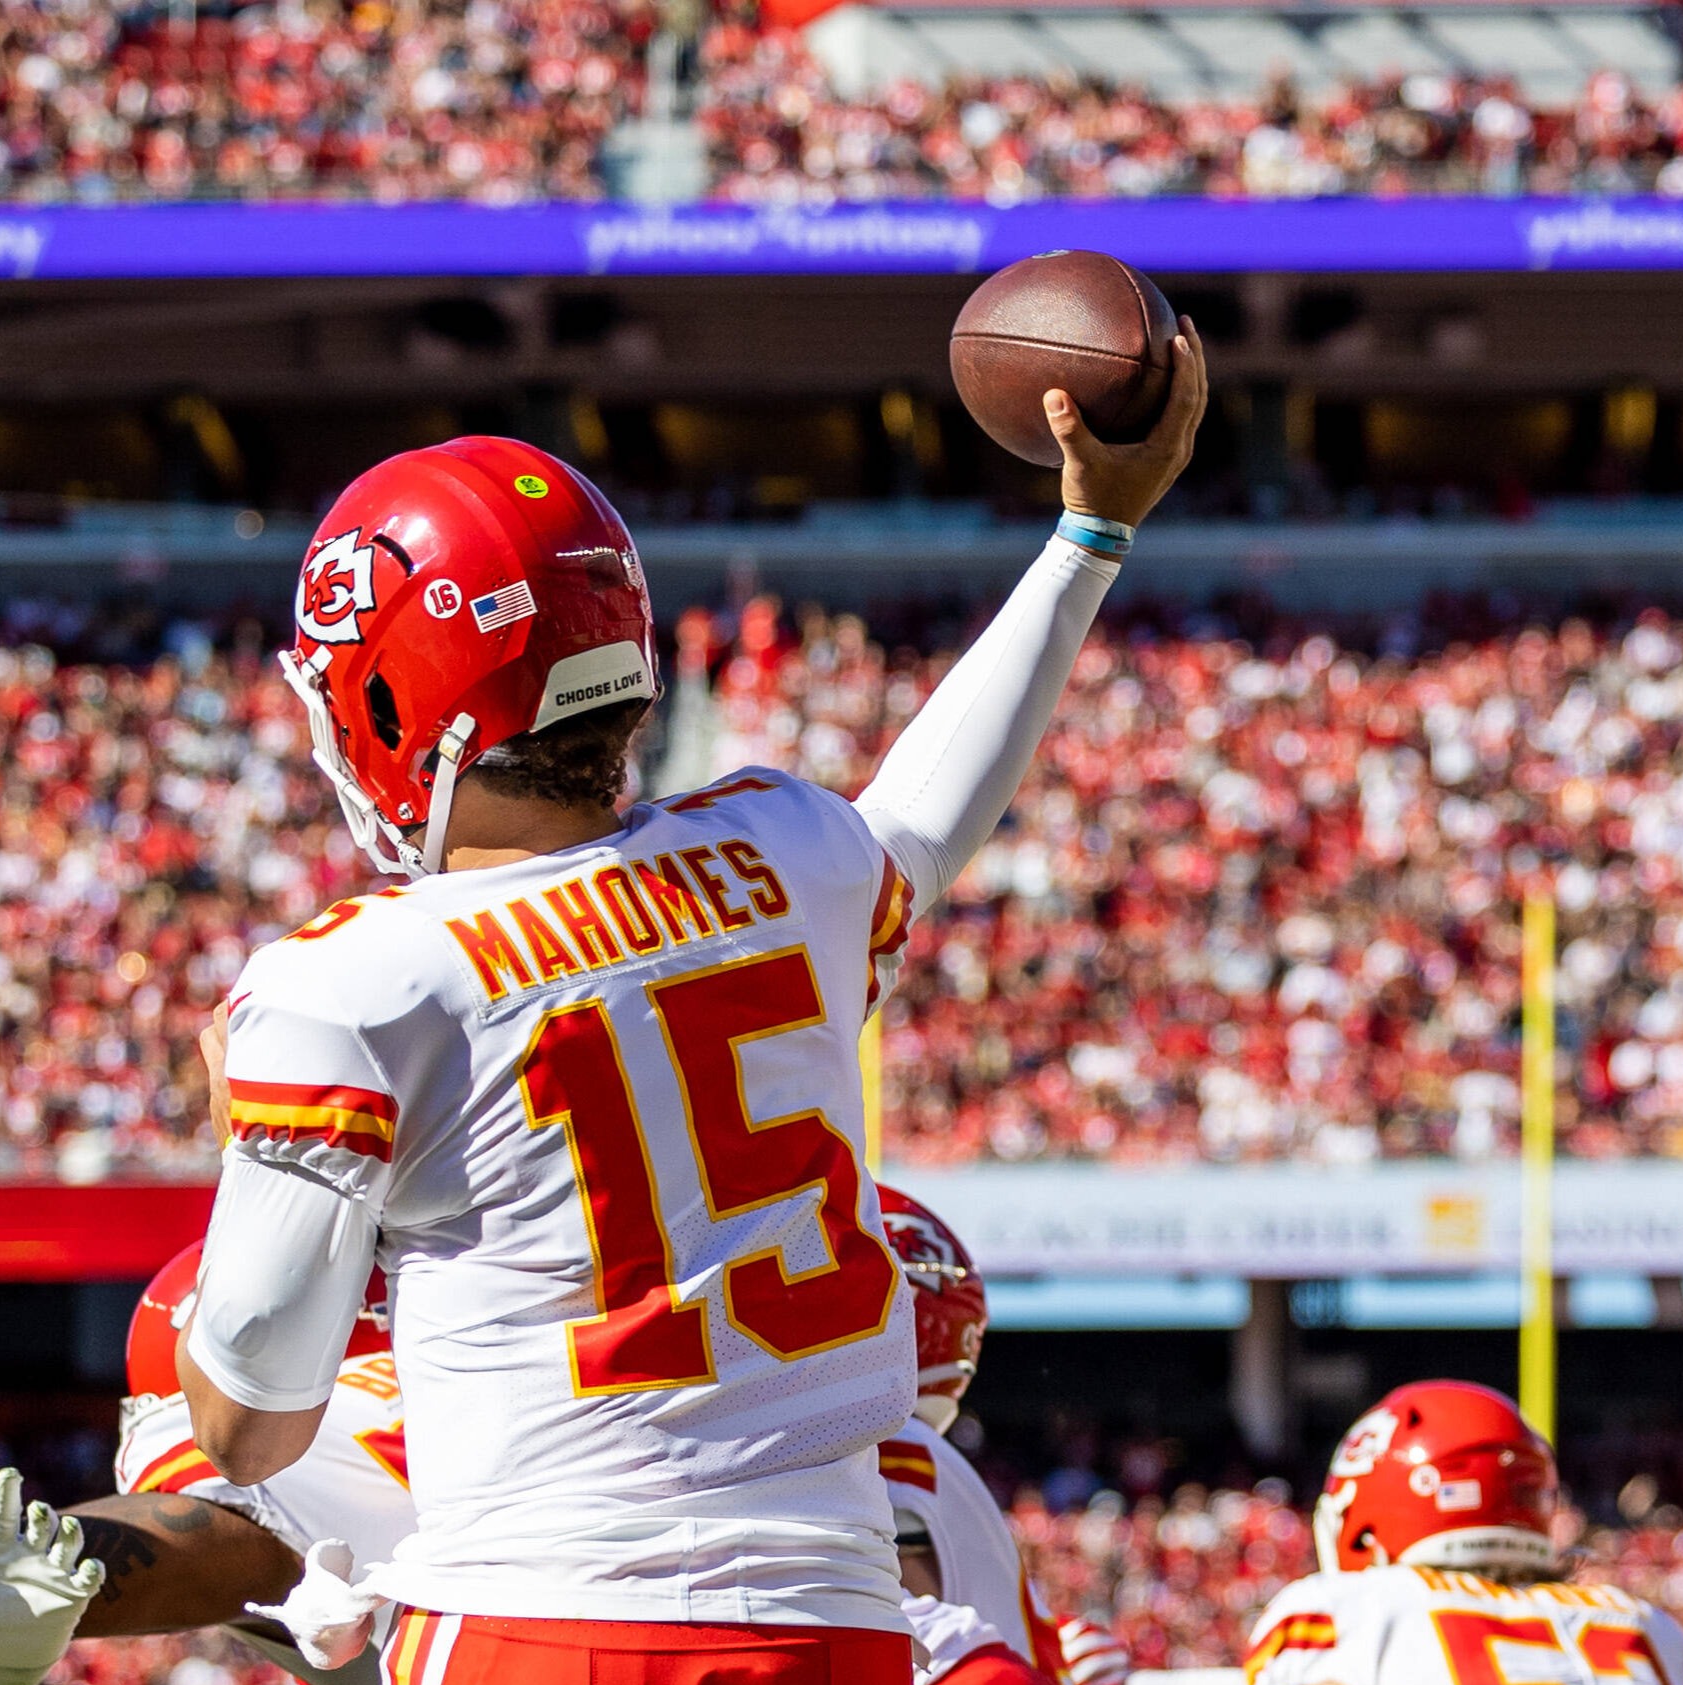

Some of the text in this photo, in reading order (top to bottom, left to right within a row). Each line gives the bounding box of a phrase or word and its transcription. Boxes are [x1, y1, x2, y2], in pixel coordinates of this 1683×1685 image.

[429, 583, 458, 615] 16
[554, 670, 644, 707] CHOOSE LOVE
[445, 838, 792, 1004] MAHOMES
[516, 942, 902, 1399] 15
